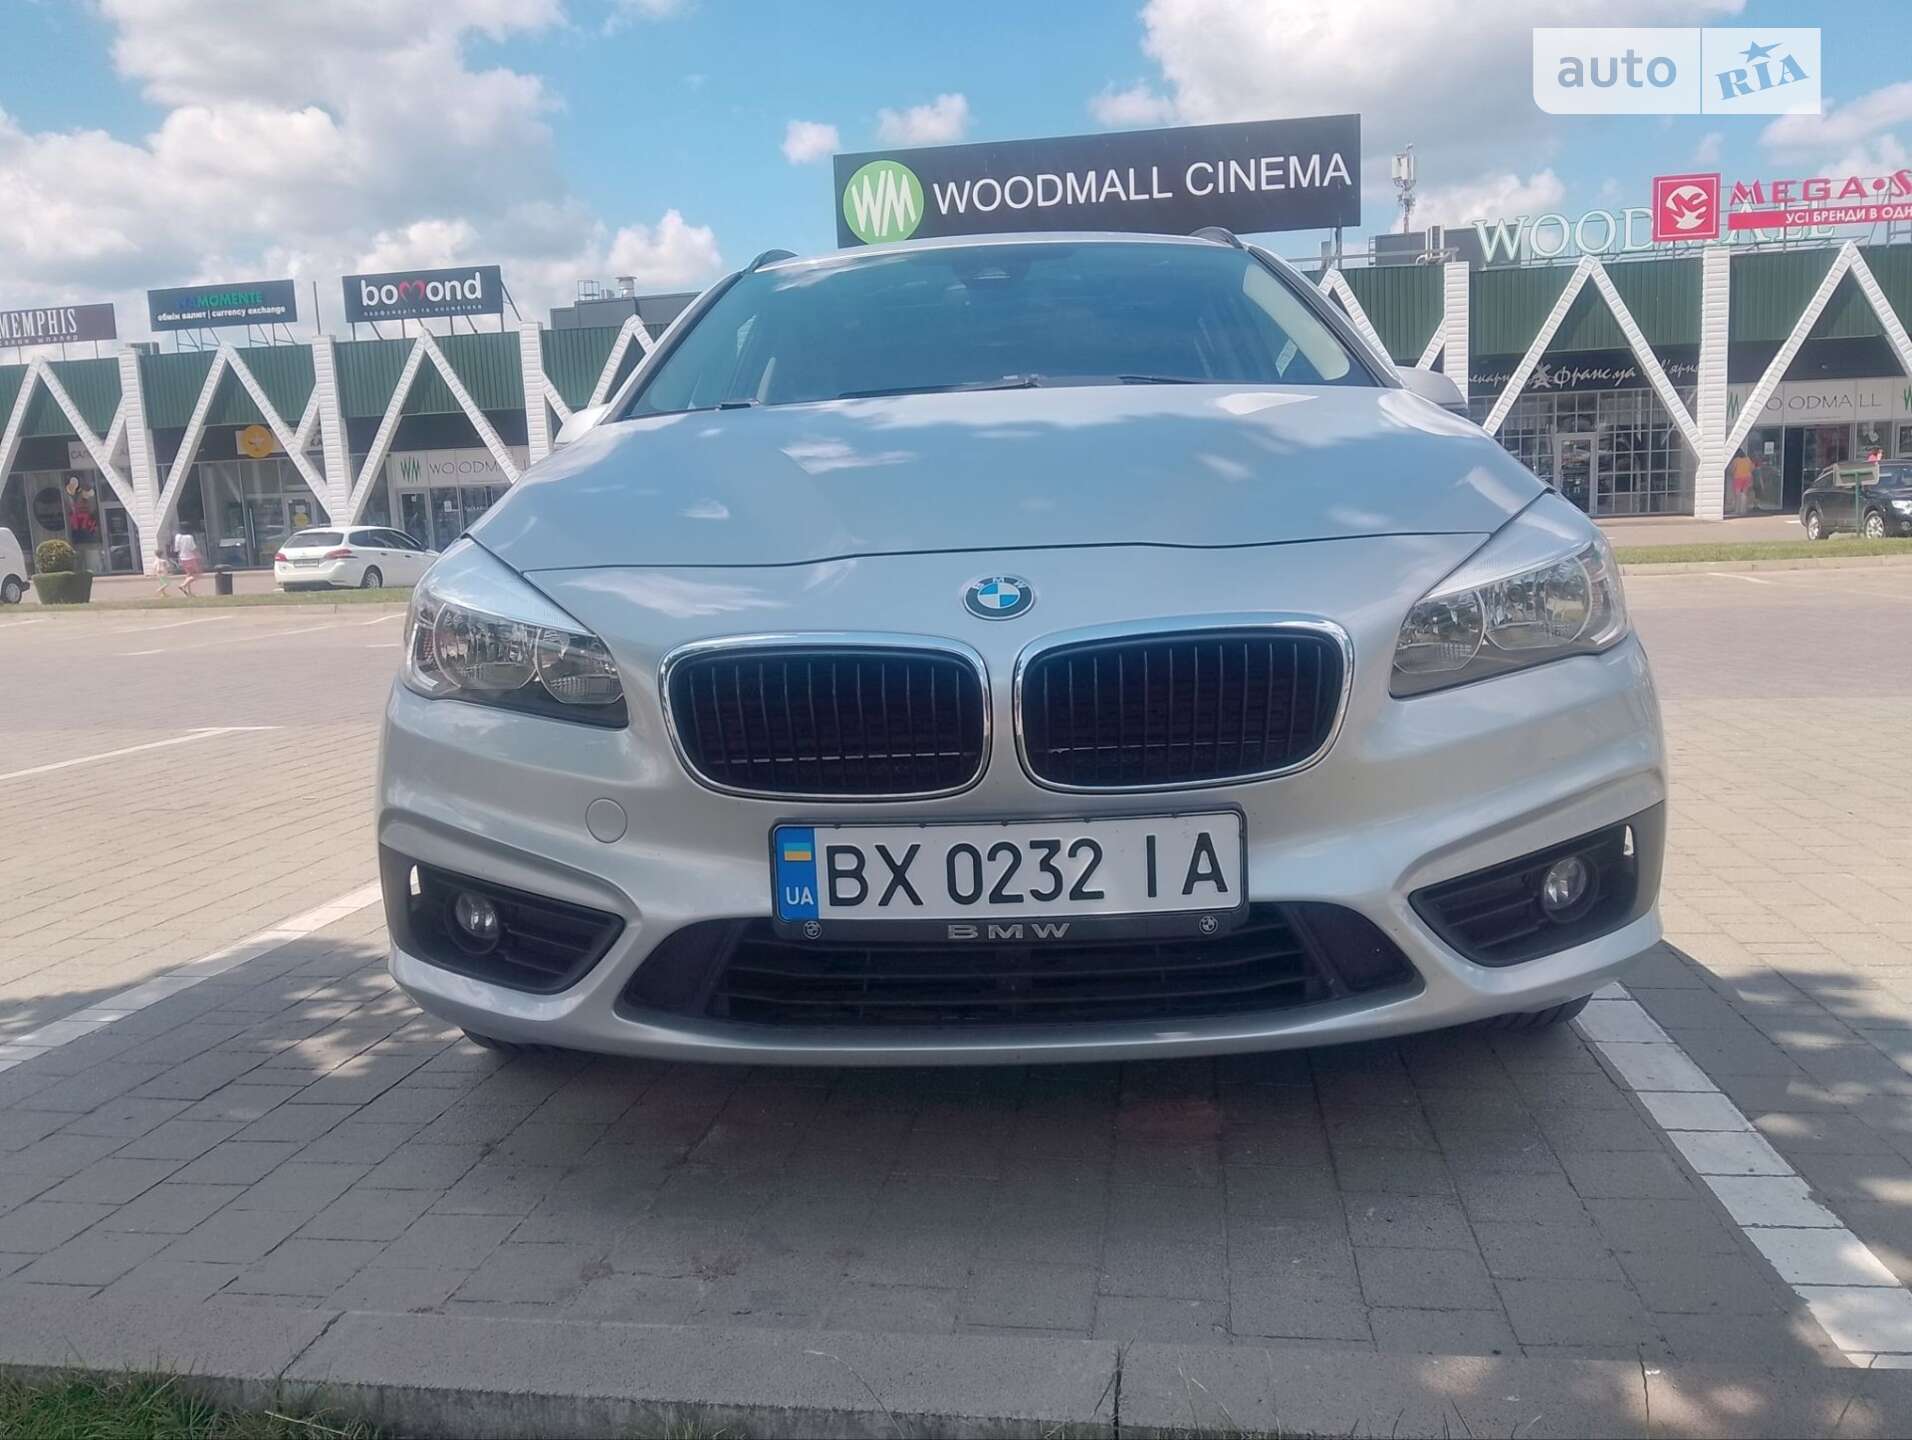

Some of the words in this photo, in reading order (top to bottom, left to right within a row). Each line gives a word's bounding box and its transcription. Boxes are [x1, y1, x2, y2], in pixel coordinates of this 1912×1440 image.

[933, 166, 1173, 216] WOODMALL
[1185, 152, 1353, 195] CINEMA
[1785, 212, 1809, 224] УСІ
[1812, 208, 1865, 222] БРЕНДИ
[1869, 207, 1878, 219] В
[360, 271, 483, 307] bomond
[0, 308, 77, 339] MEMPHIS
[212, 308, 246, 318] currency
[247, 305, 286, 316] exchange
[826, 844, 925, 907] BX
[946, 838, 1105, 906] 0232
[1146, 832, 1229, 898] IA
[786, 886, 814, 906] UA
[946, 921, 1071, 941] BMW
